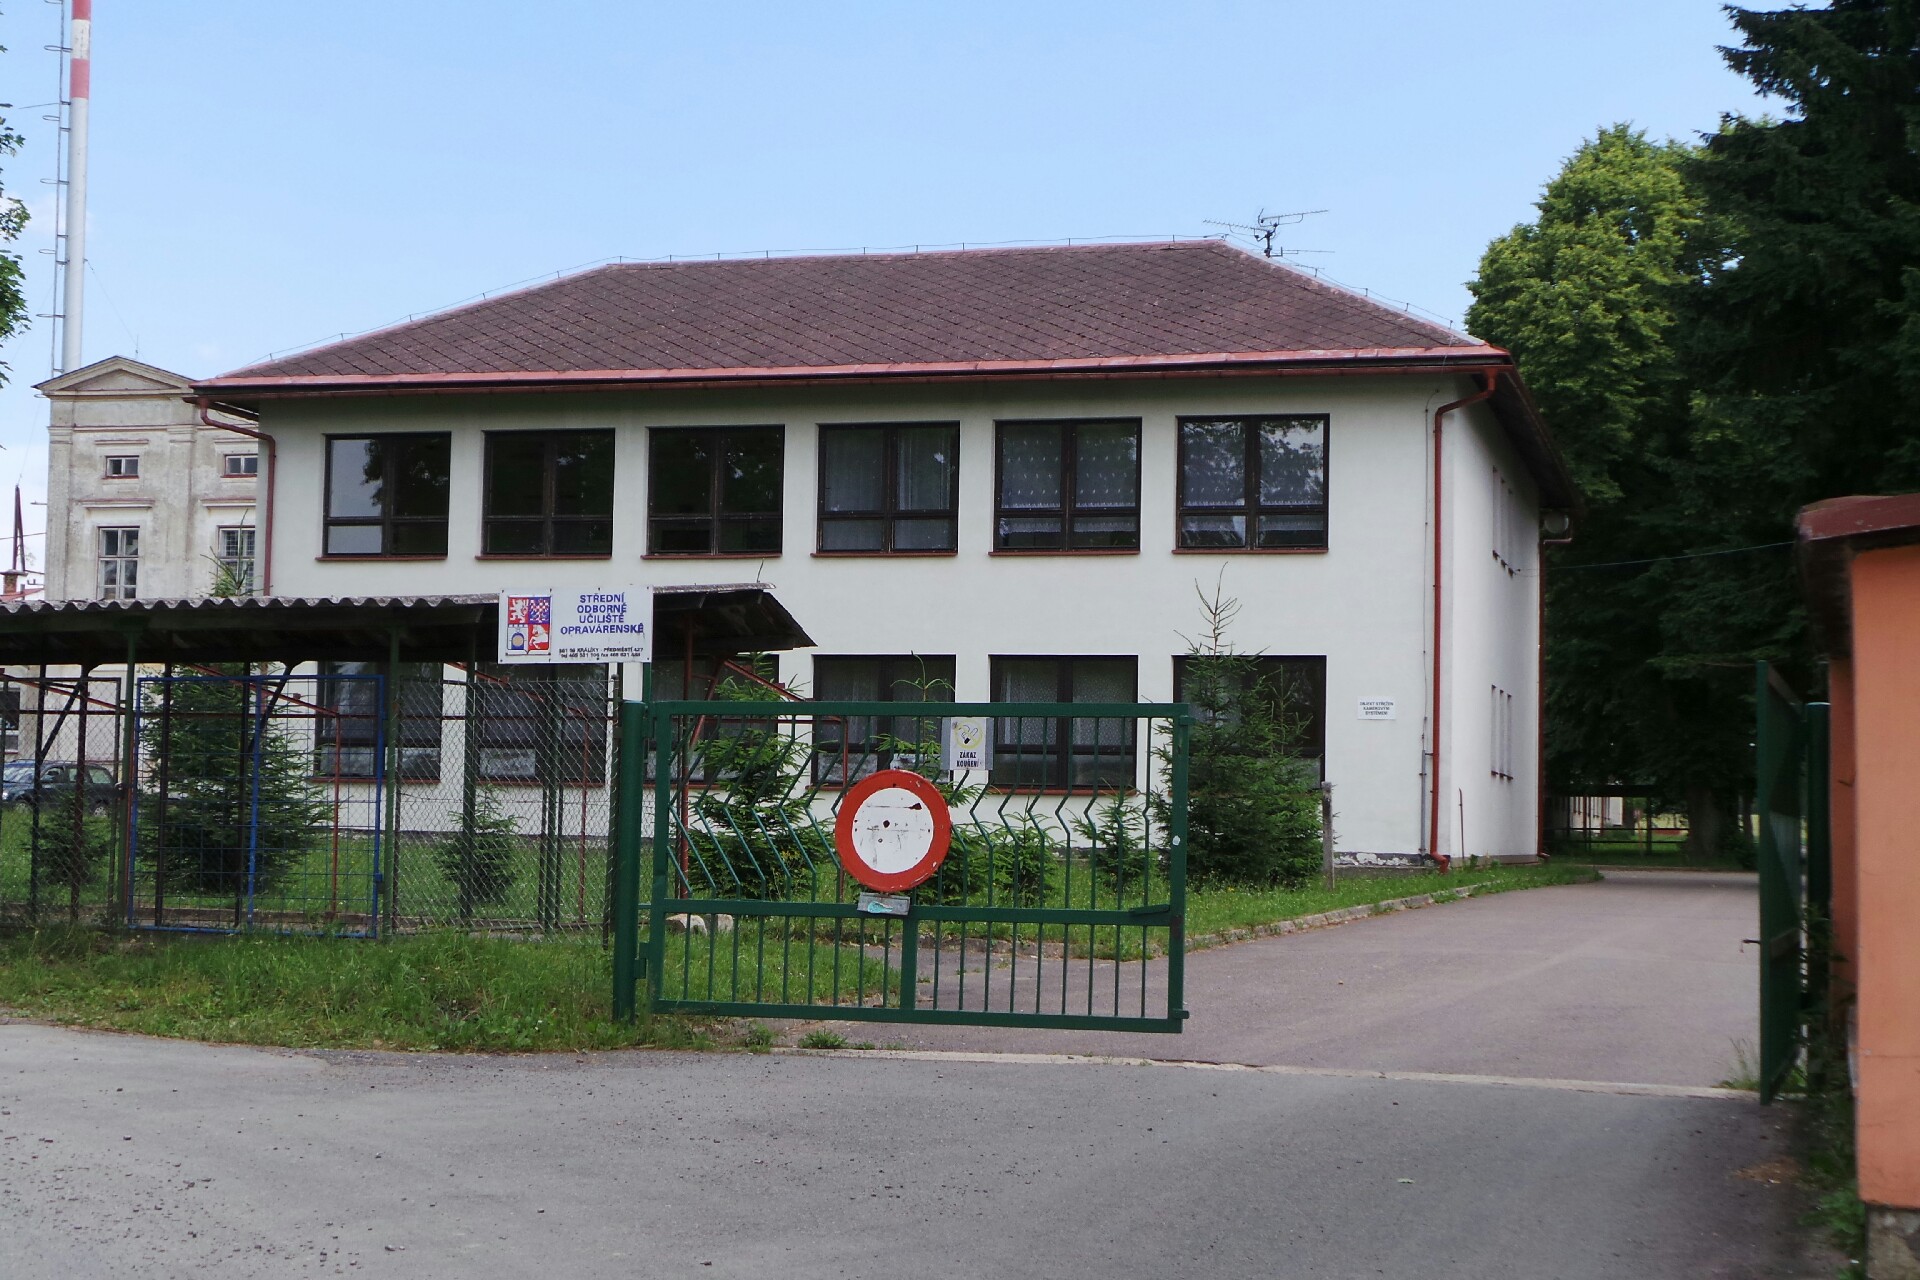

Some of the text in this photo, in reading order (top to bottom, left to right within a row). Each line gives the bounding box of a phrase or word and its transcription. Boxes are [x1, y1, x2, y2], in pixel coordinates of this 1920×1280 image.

[580, 592, 625, 603] STŘEDNÍ
[577, 602, 627, 613] ODBORNÉ
[579, 612, 624, 623] UČILIŠTĚ
[560, 623, 644, 634] OPRAVÁRENSKÉ
